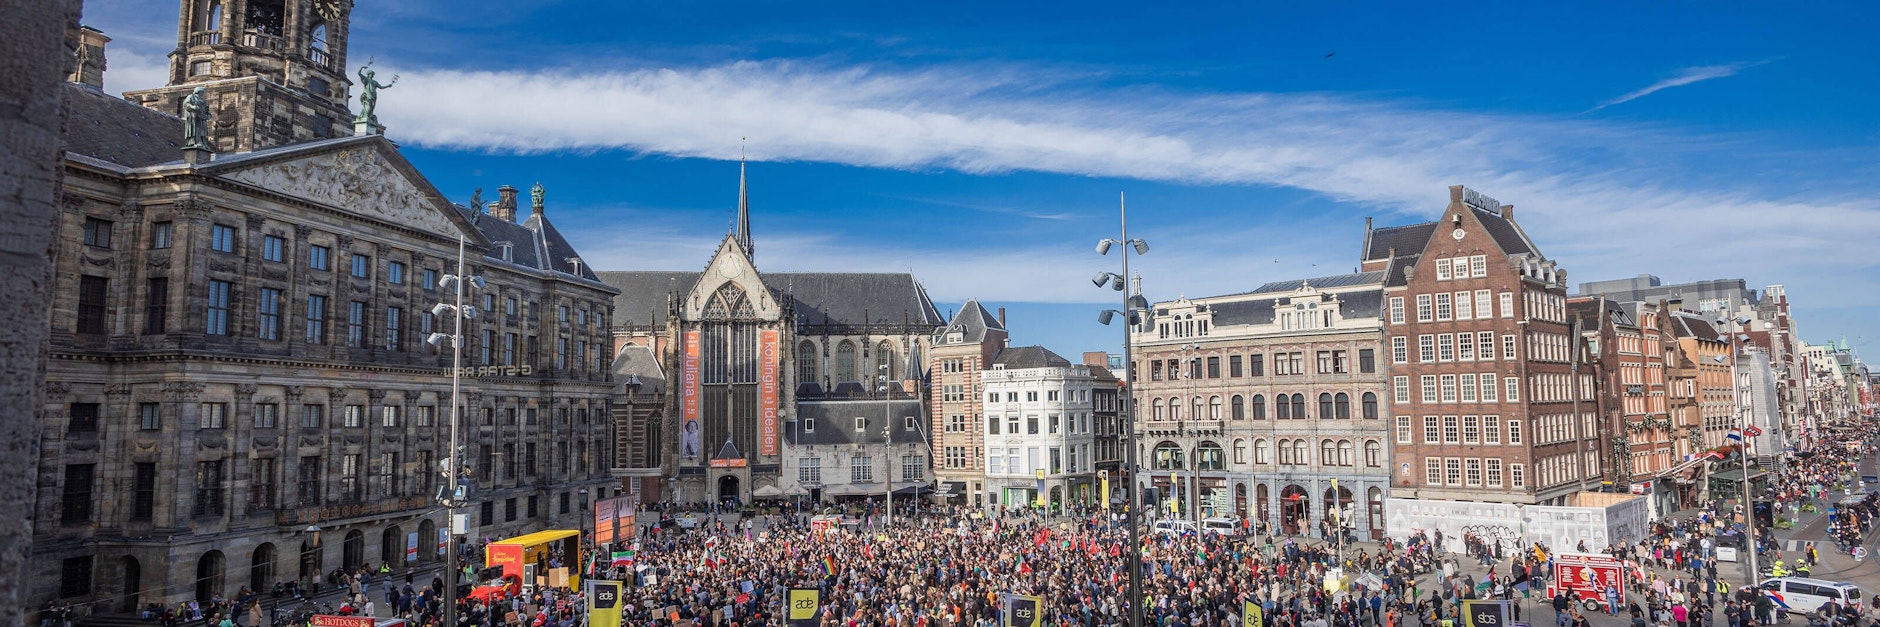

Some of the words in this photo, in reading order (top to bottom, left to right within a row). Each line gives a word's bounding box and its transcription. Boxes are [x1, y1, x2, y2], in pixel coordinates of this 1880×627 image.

[685, 352, 698, 396] Juliana
[762, 341, 776, 393] koningin
[764, 407, 776, 453] idealen
[599, 591, 614, 600] ade
[795, 596, 814, 610] ade
[1016, 607, 1031, 619] ade
